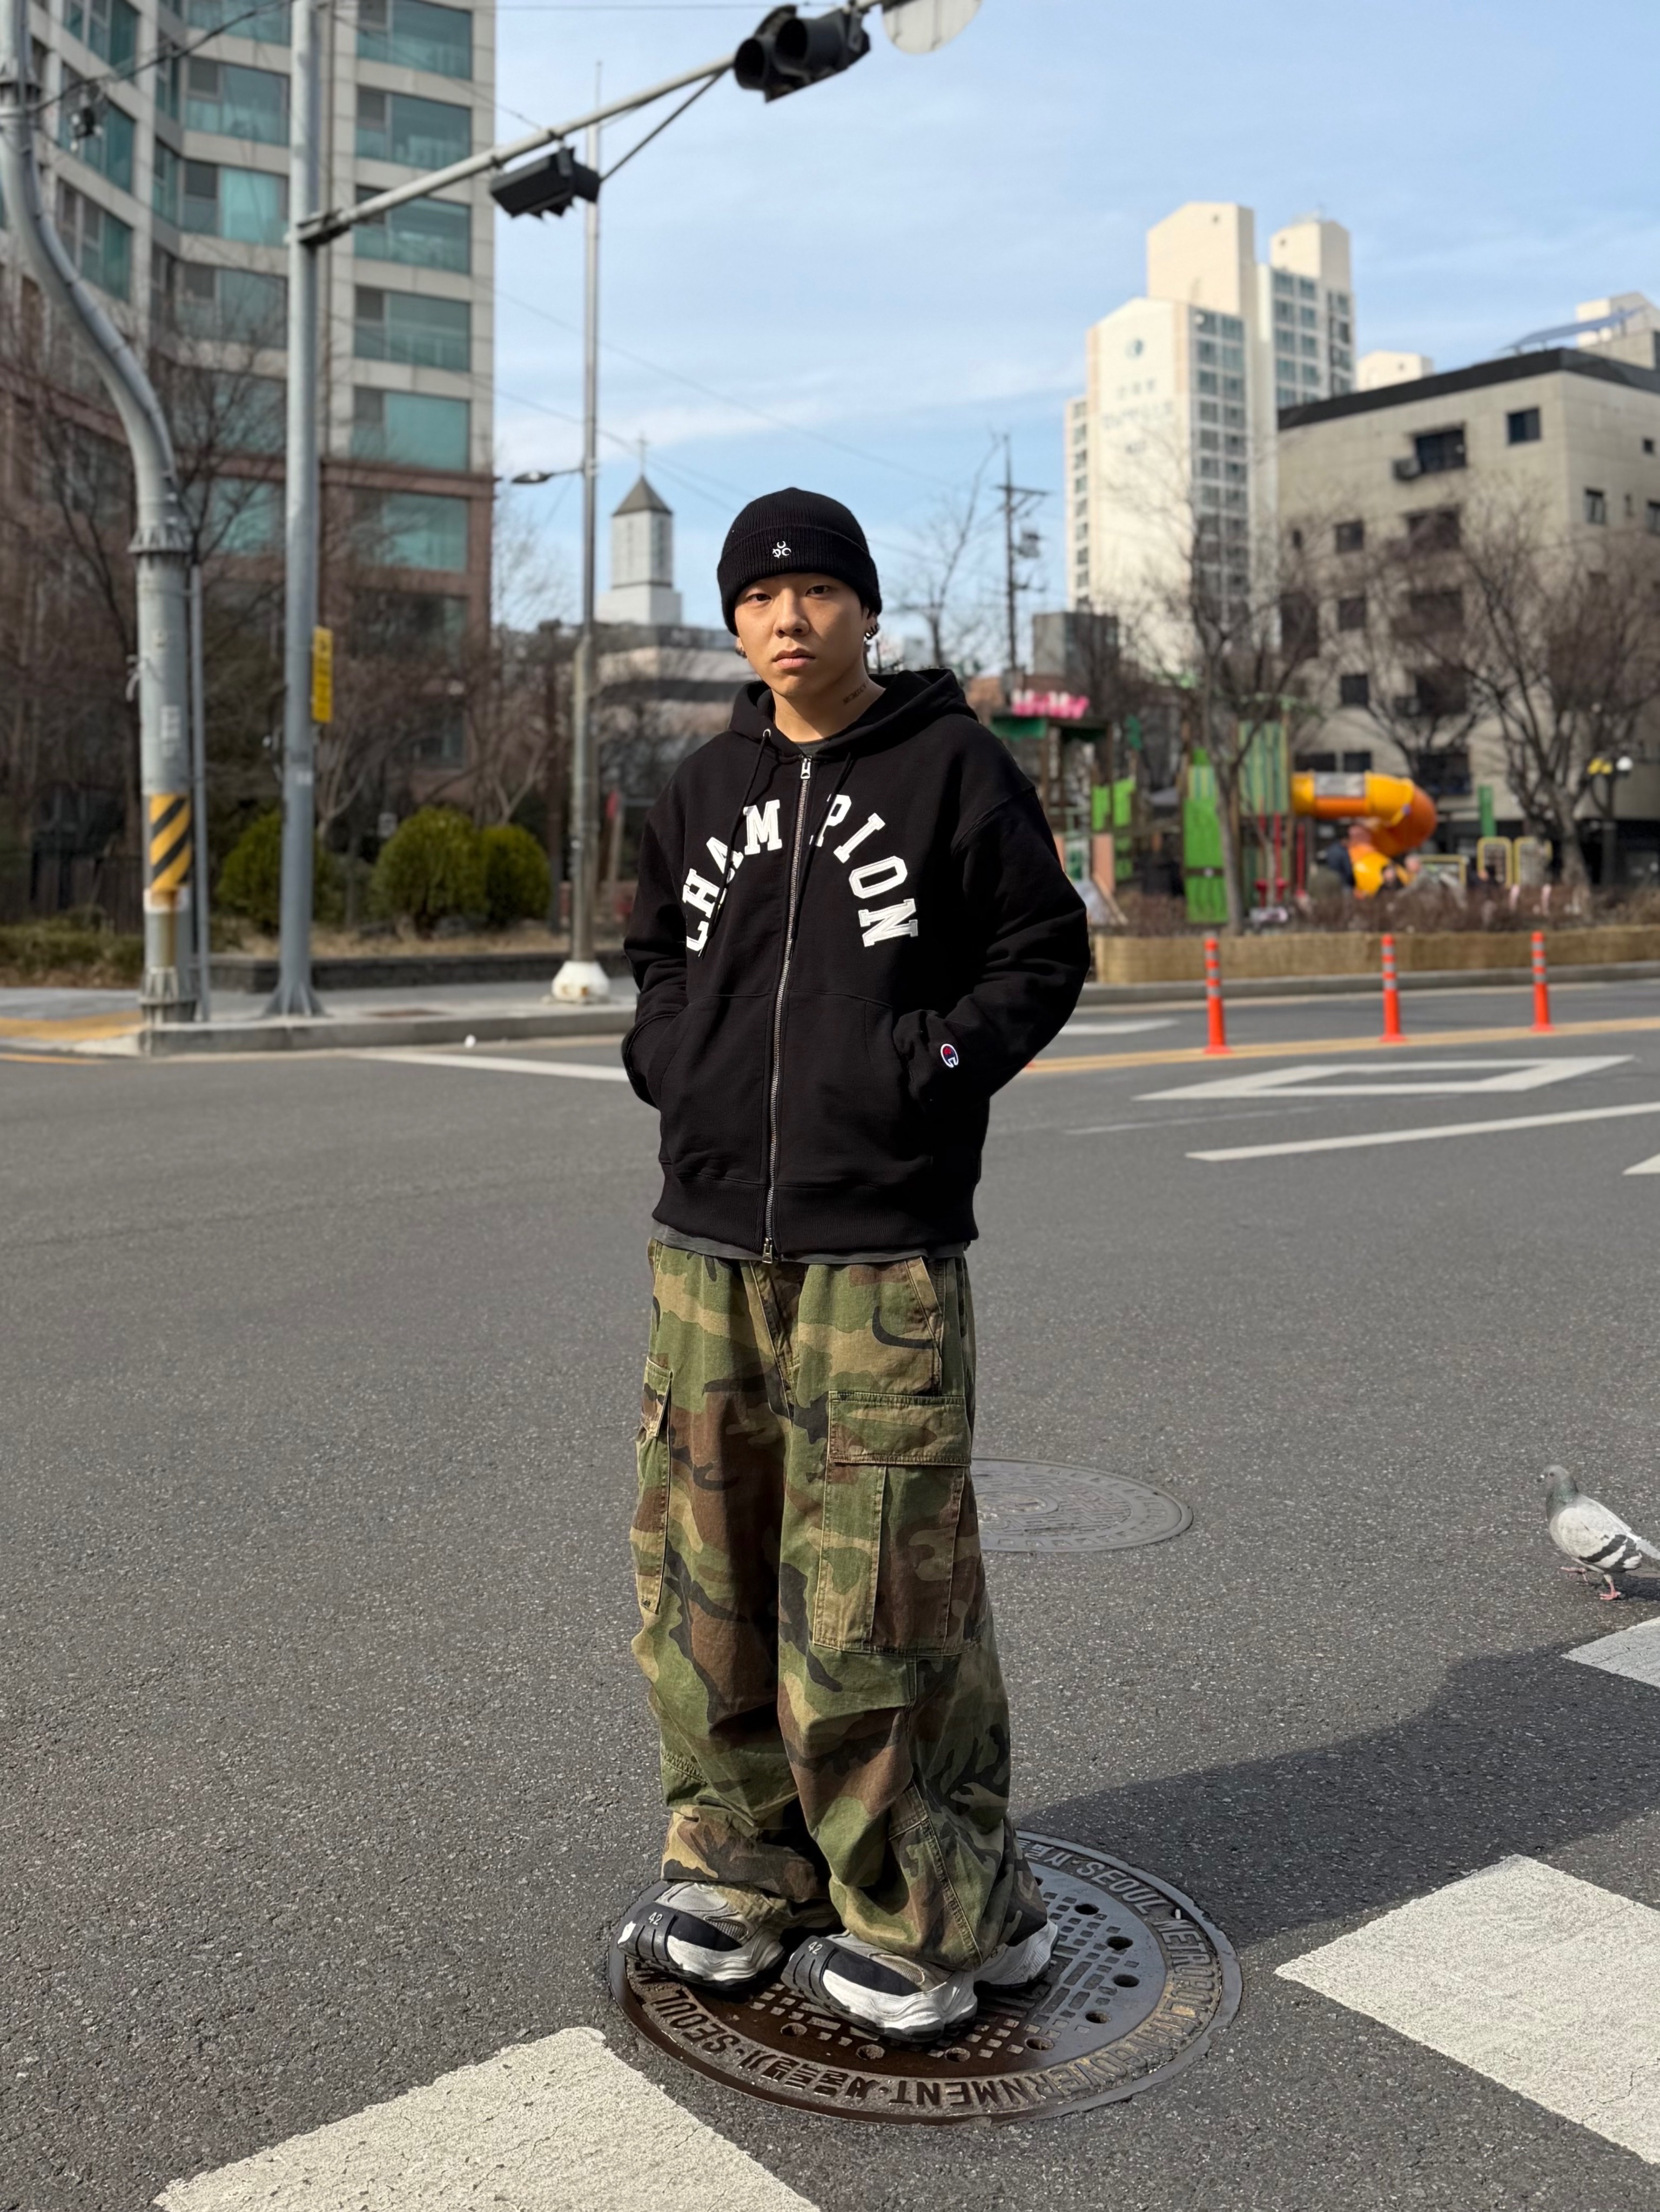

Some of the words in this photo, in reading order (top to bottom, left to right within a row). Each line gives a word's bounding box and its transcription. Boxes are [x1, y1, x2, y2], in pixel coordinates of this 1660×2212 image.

[682, 793, 918, 952] CHAMPION
[1076, 1861, 1168, 1915] SEOUL
[648, 1912, 663, 1926] 42
[808, 1941, 823, 1955] 42
[1126, 1919, 1215, 2056] METROPOLITAN
[650, 1990, 739, 2053] SEOUL
[737, 2050, 879, 2101] 서울특별시
[889, 2047, 1148, 2106] GOVERNMENT
